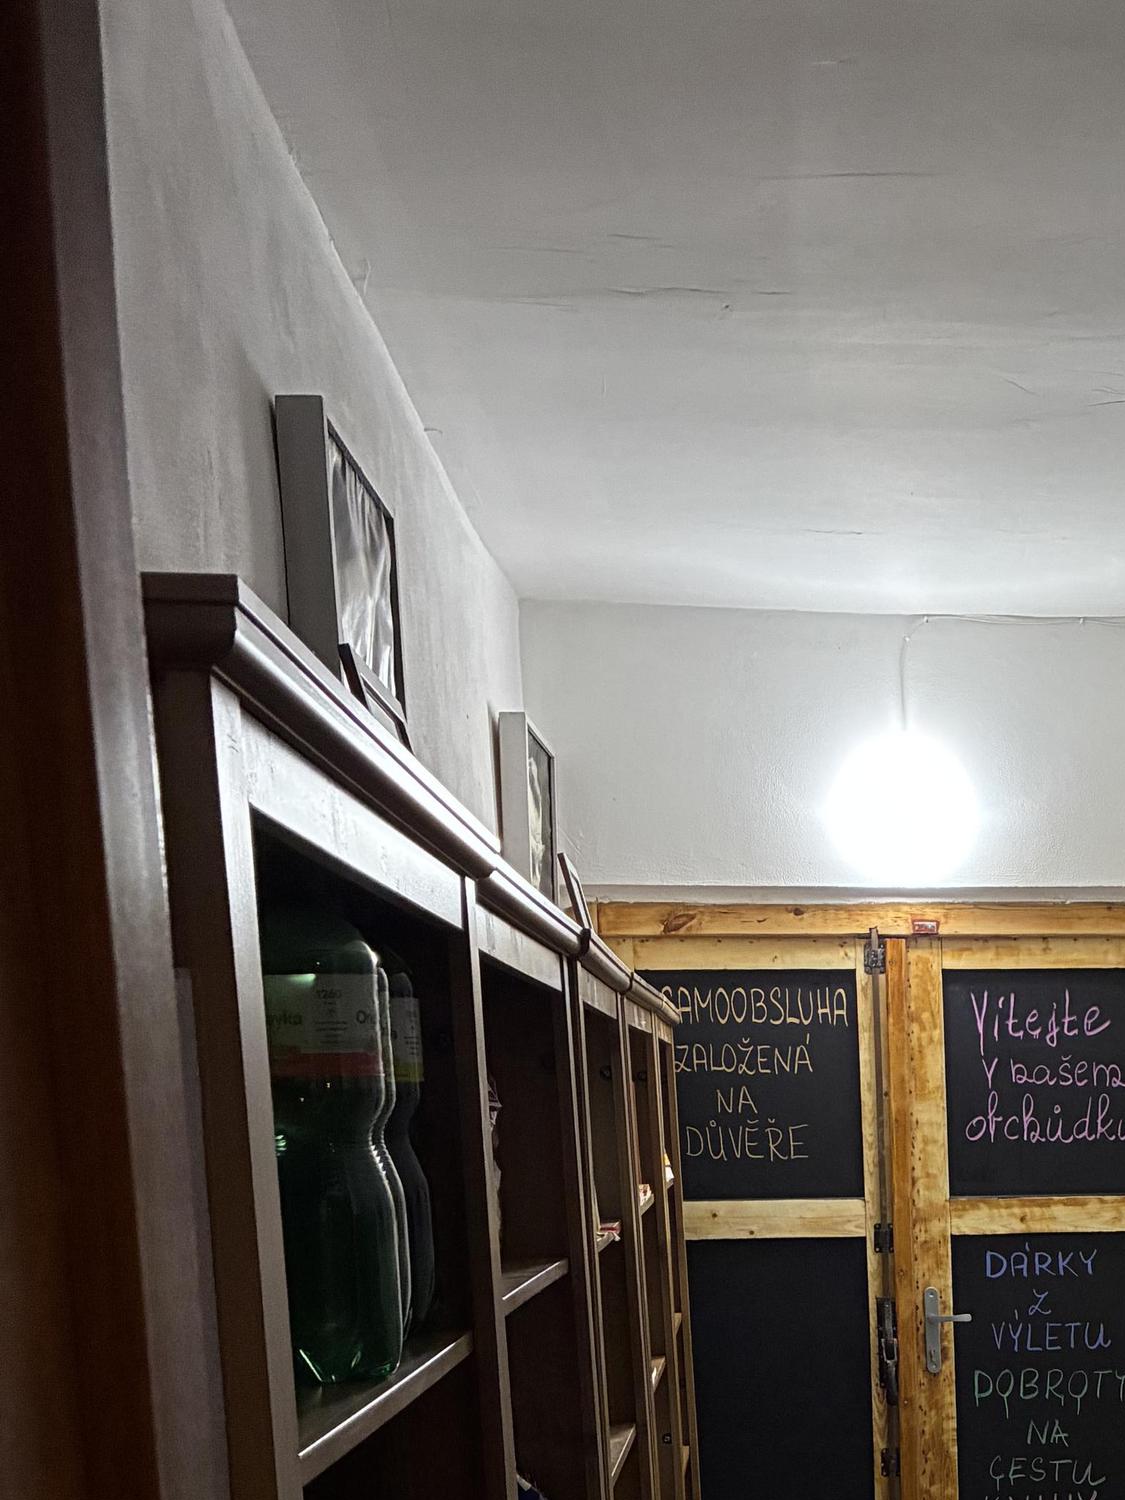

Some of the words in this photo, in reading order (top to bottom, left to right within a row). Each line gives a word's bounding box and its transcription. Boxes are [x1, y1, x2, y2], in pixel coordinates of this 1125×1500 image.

[971, 989, 1111, 1056] Vítejte
[675, 1033, 813, 1075] ZALOŽENÁ
[716, 1086, 759, 1114] NA
[686, 1118, 808, 1161] DŮVĚŘE
[986, 1242, 1097, 1279] DÁRKY
[991, 1309, 1112, 1352] VÝLETU
[1027, 1420, 1069, 1447] NA
[990, 1456, 1106, 1487] CESTU
